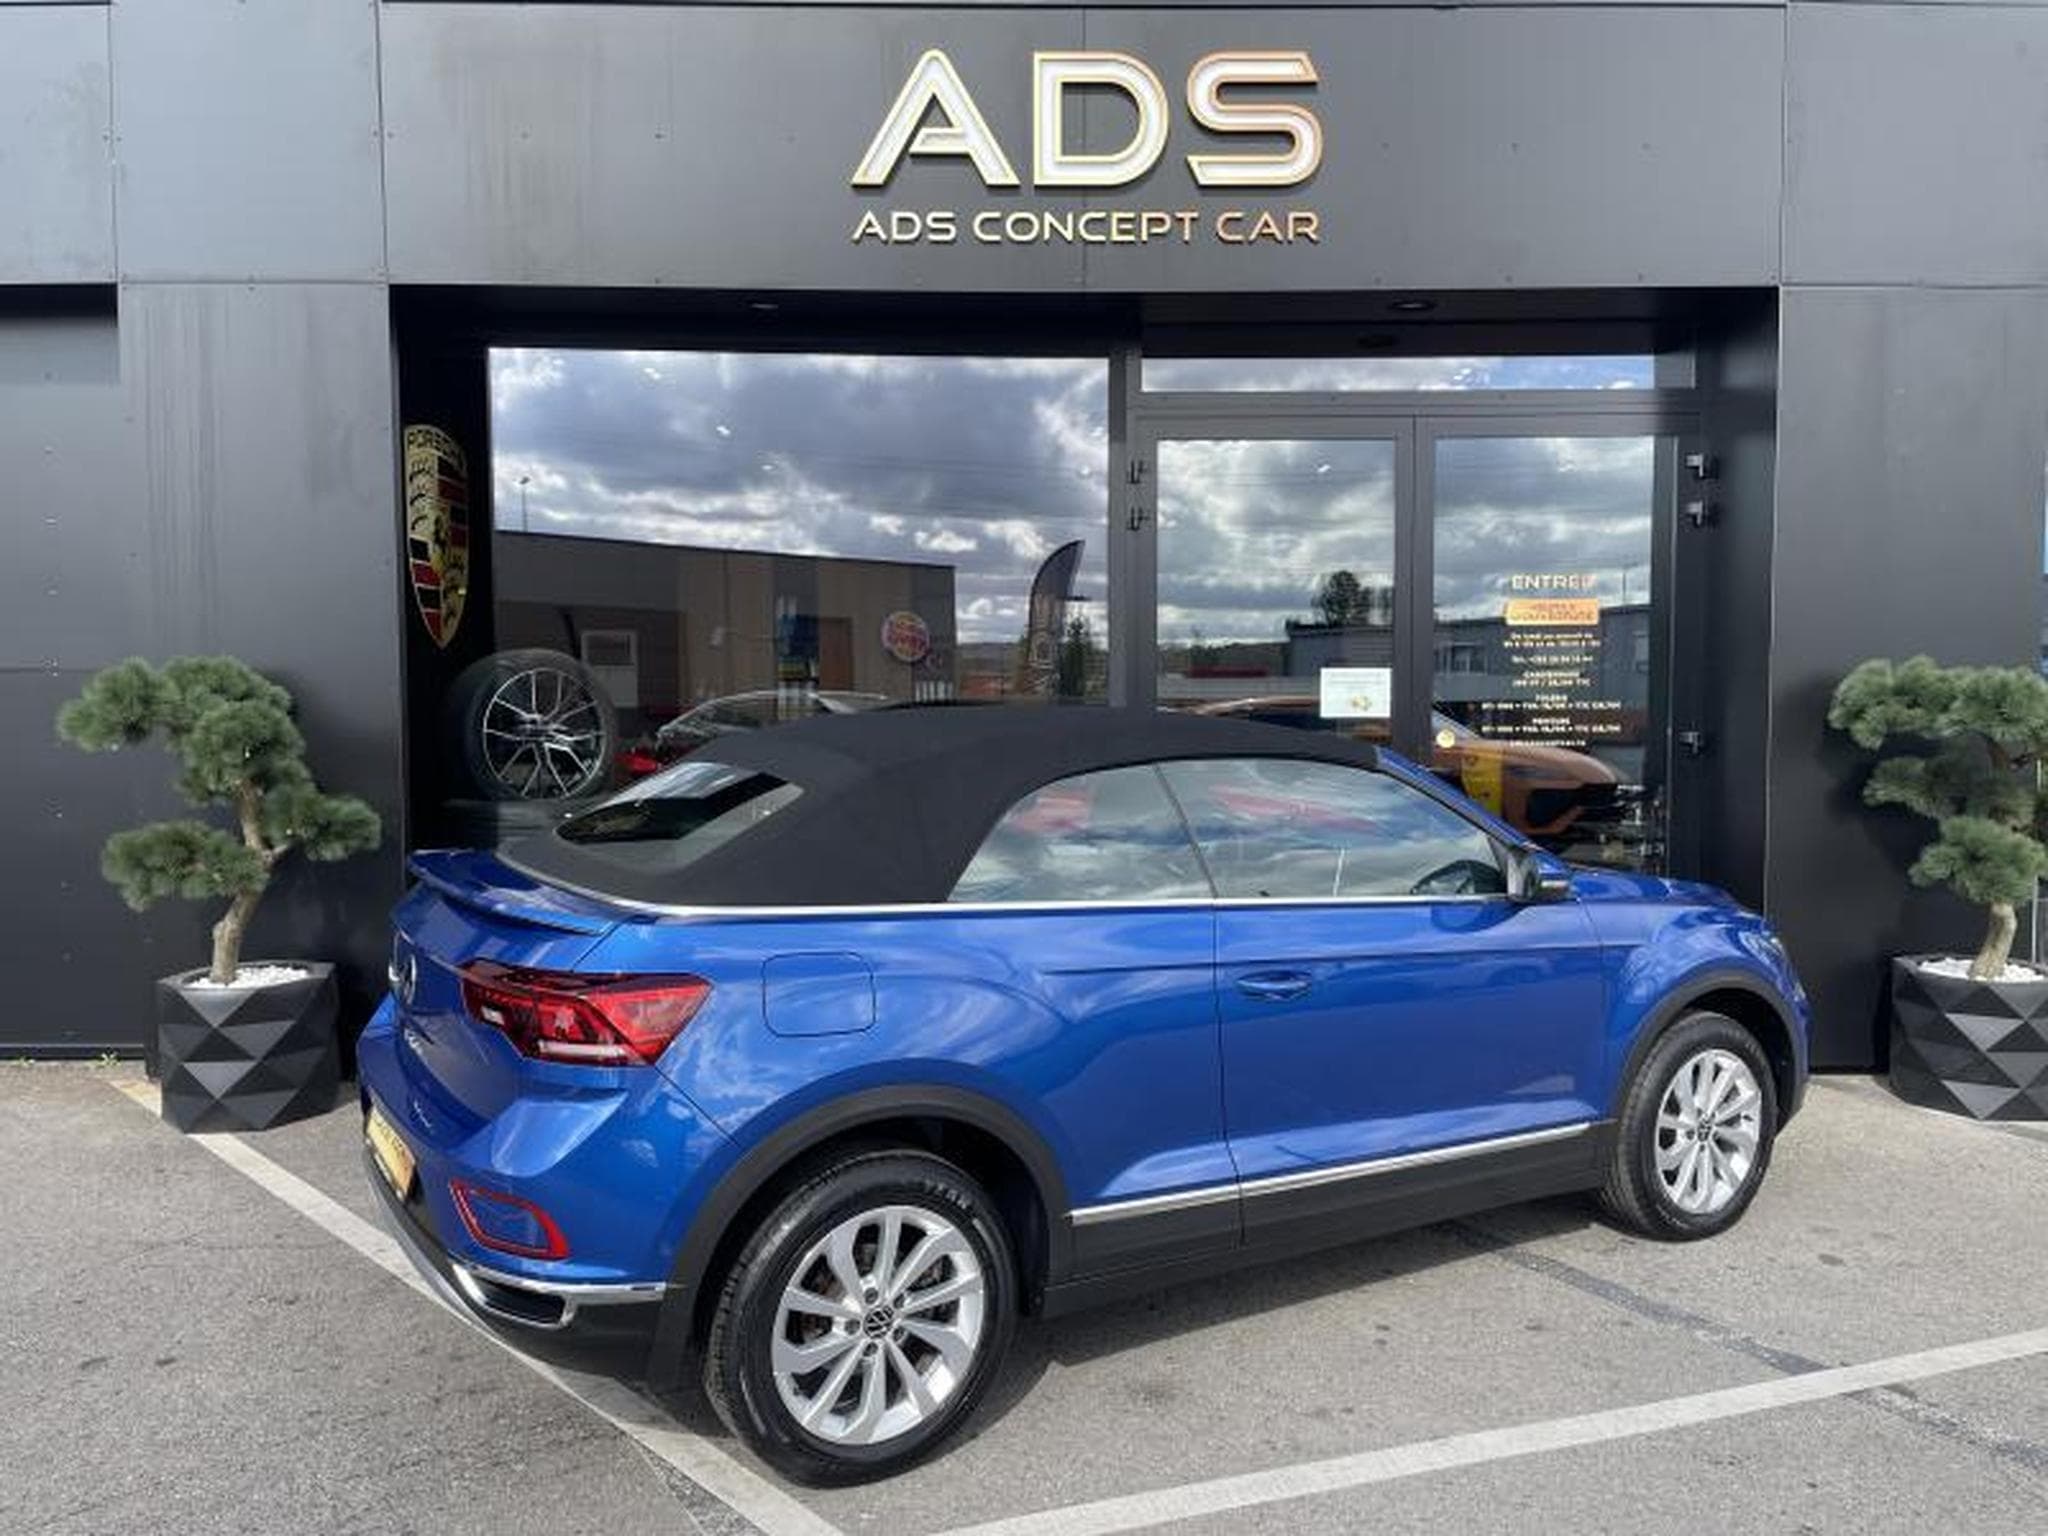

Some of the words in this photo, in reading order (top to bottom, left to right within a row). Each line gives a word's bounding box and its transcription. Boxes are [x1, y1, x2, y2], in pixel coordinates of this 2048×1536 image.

[850, 48, 1324, 187] ADS
[852, 210, 956, 243] ADS
[973, 210, 1199, 243] CONCEPT
[1216, 210, 1321, 243] CAR
